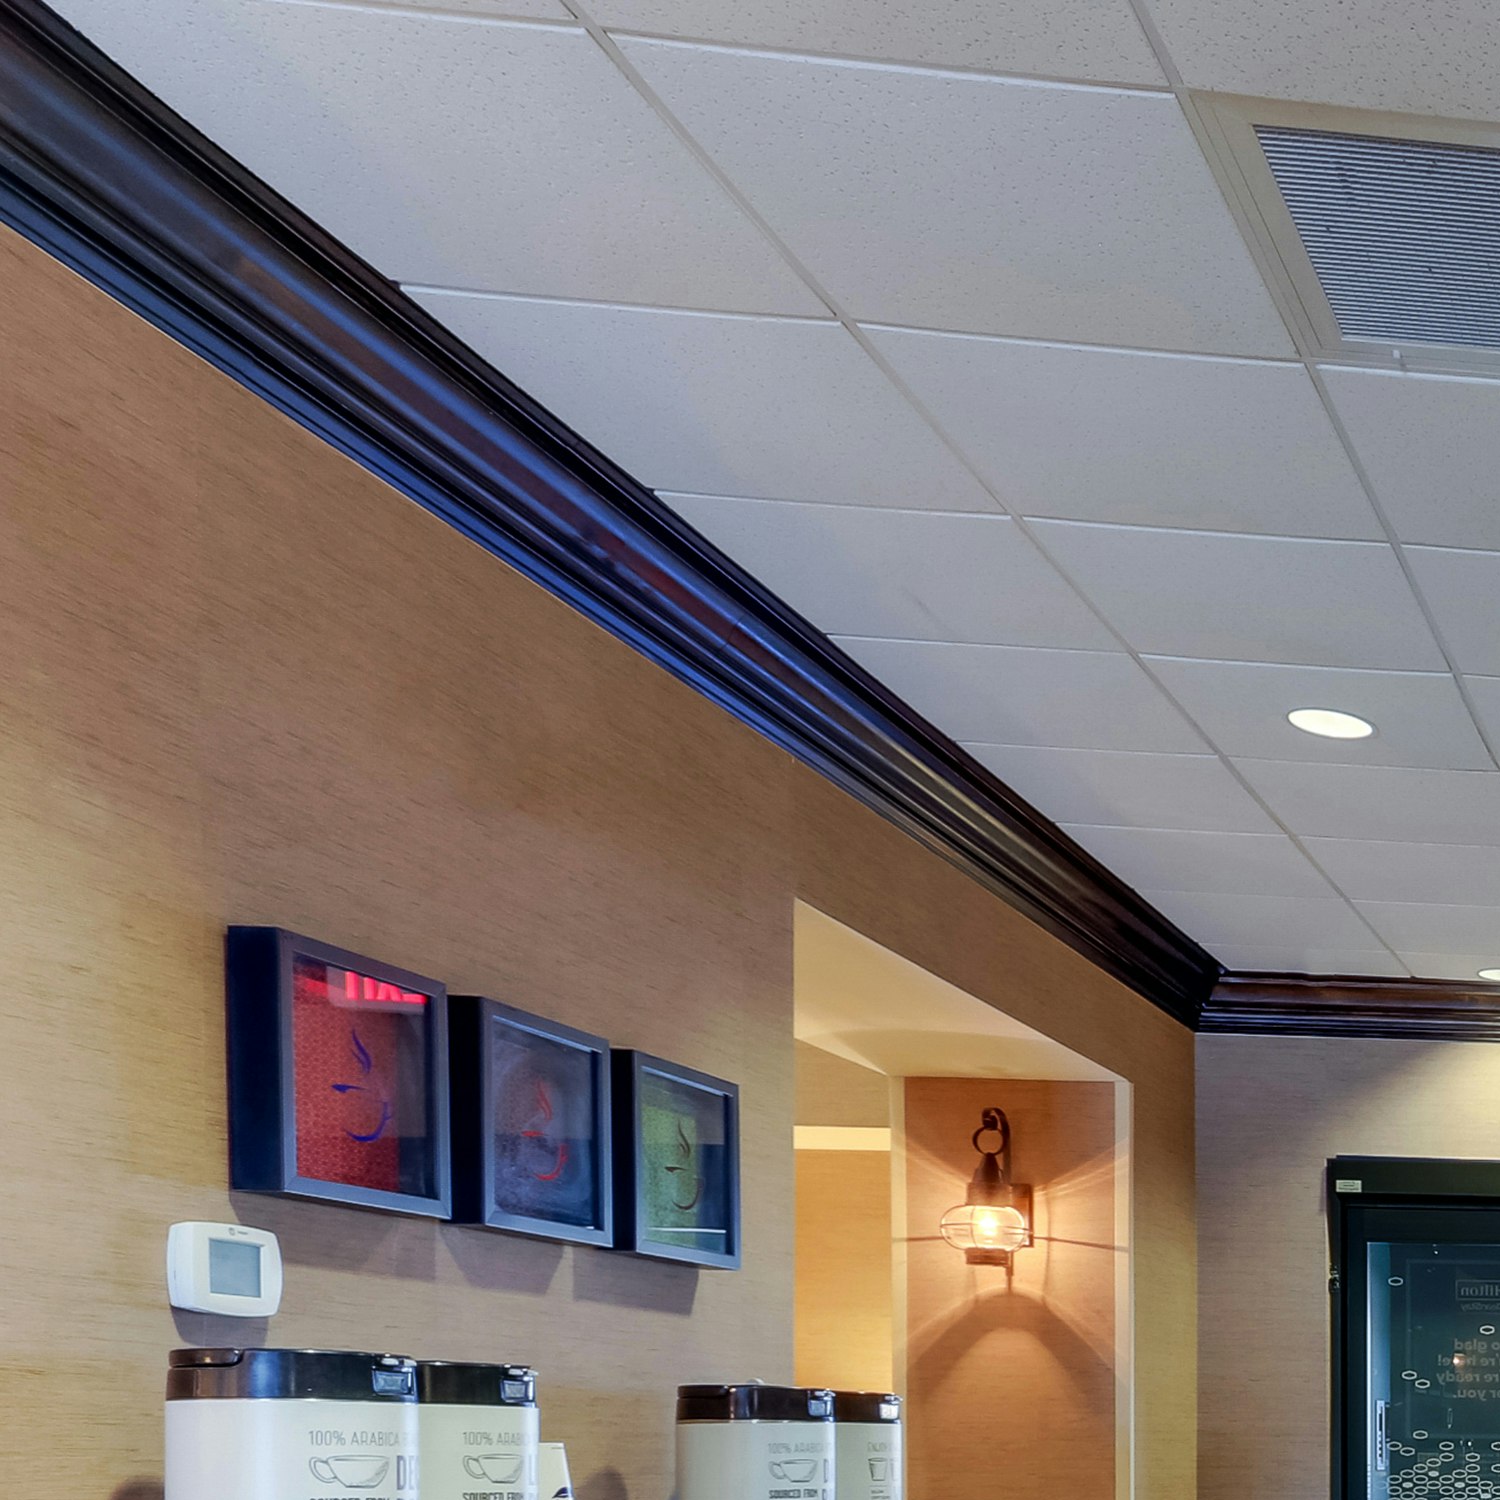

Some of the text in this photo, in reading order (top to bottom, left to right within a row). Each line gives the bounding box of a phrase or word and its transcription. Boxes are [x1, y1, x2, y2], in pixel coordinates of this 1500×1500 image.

[308, 1430, 346, 1446] 100%
[350, 1431, 400, 1447] ARABICA
[462, 1431, 493, 1446] 100%
